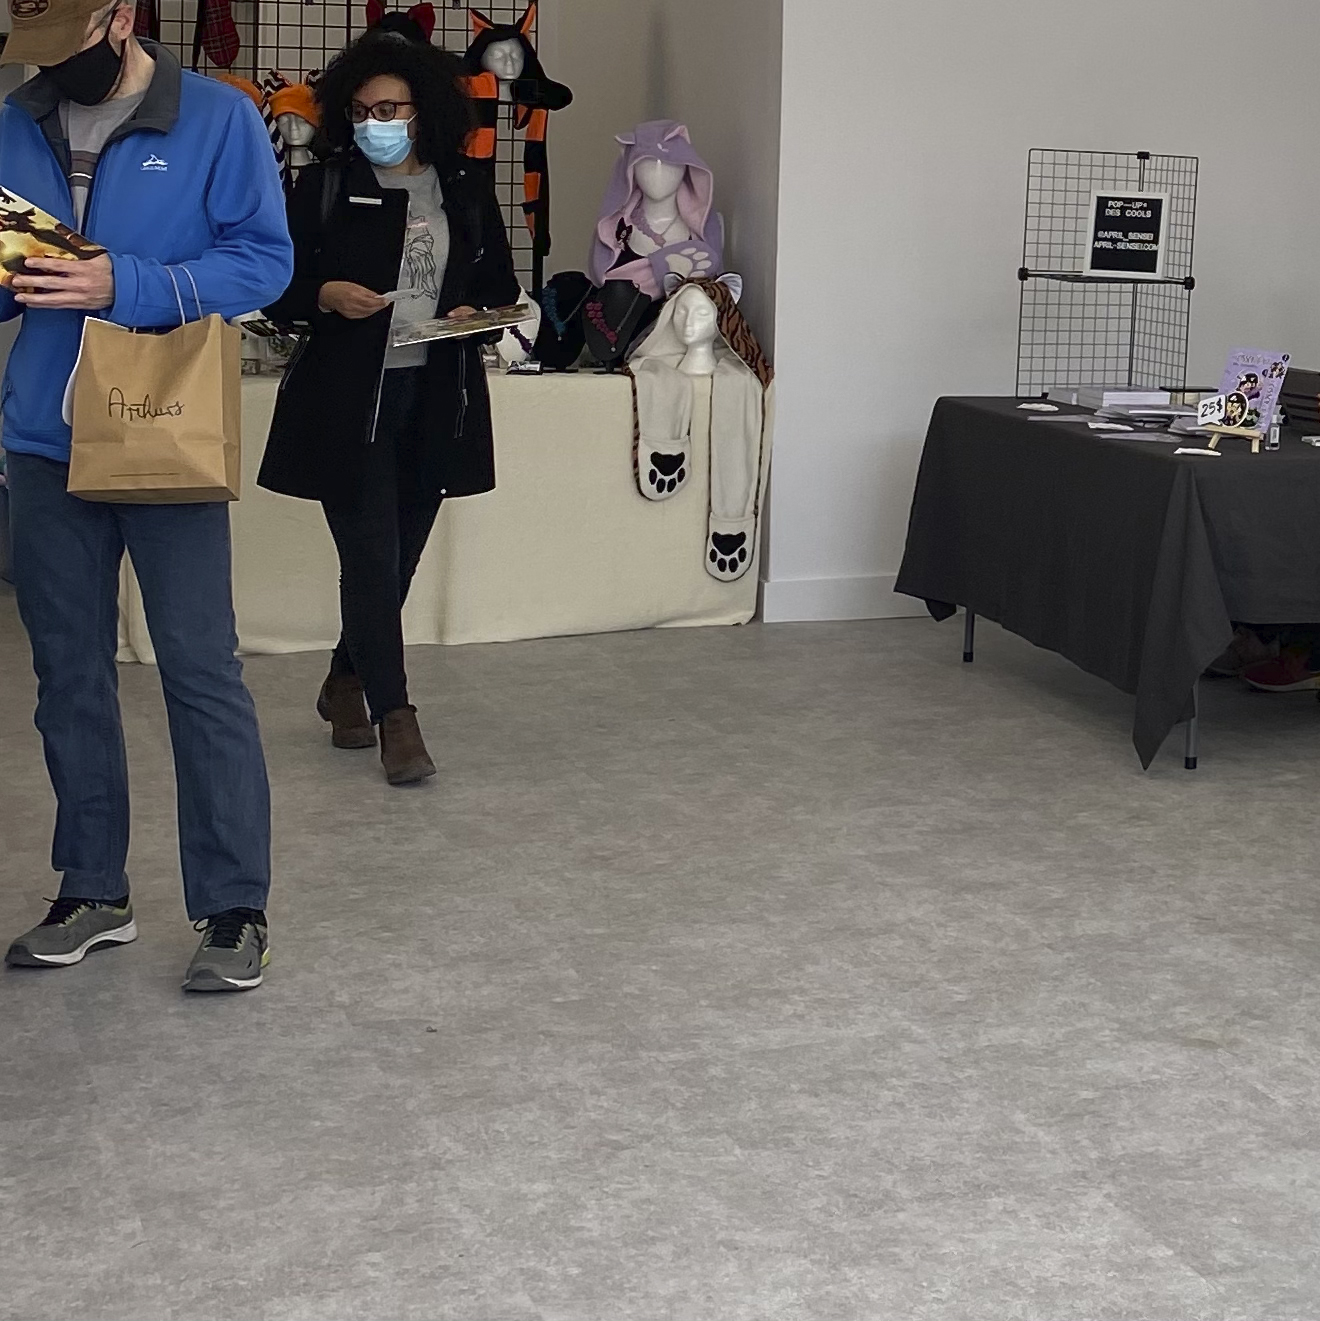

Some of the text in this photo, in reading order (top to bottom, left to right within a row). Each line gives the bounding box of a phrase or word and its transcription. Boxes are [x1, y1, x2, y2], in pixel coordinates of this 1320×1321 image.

[1105, 208, 1152, 218] DES COOLS
[1200, 397, 1223, 418] 25$
